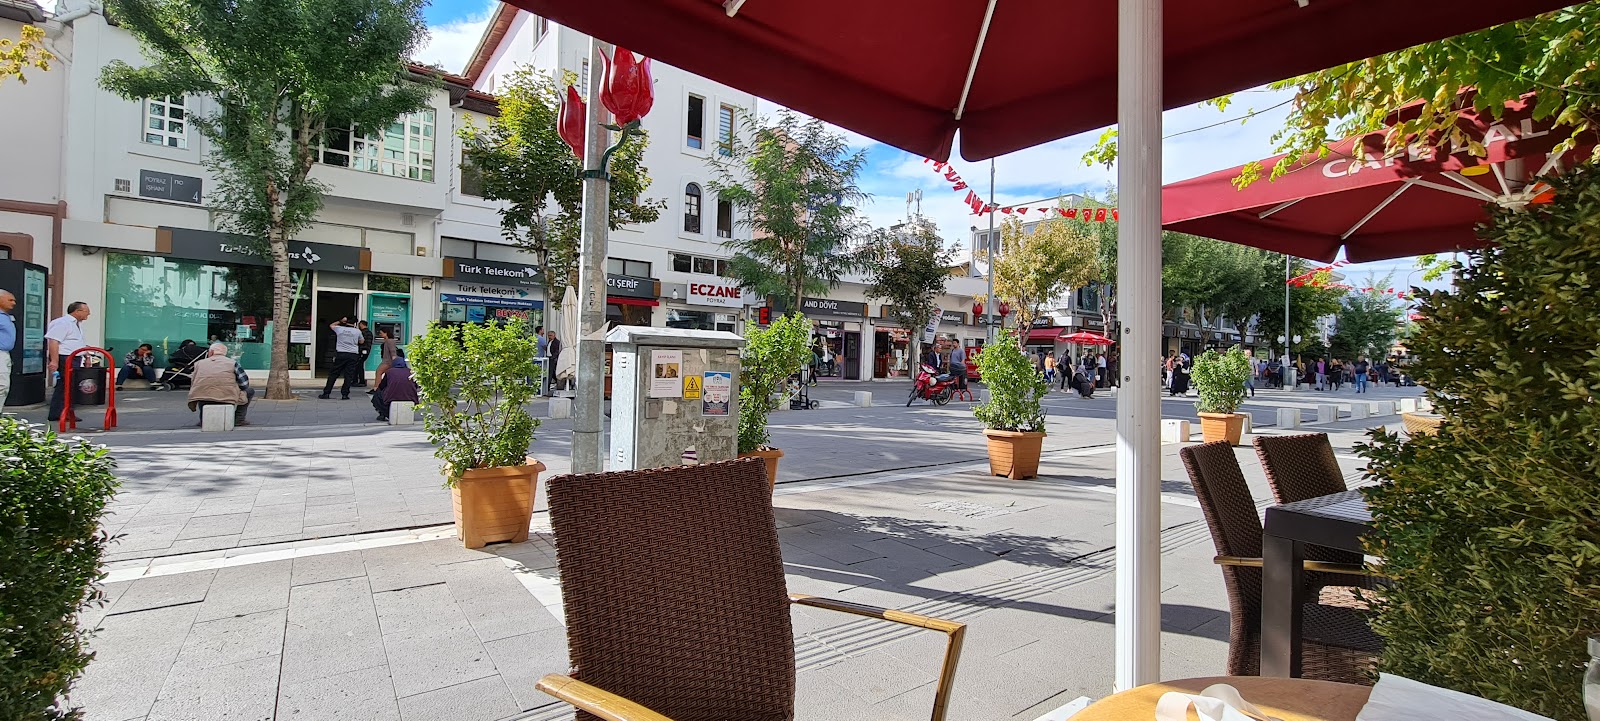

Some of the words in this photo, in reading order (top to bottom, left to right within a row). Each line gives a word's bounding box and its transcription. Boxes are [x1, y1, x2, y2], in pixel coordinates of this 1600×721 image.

[145, 176, 167, 185] POYRAZ
[192, 190, 199, 202] 4
[459, 263, 481, 274] Türk
[484, 266, 524, 278] Telekom
[457, 284, 477, 293] Türk
[480, 286, 515, 296] Telekom
[616, 279, 639, 289] ŞERİF
[690, 283, 741, 299] ECZANE
[804, 300, 817, 308] AND
[819, 300, 838, 310] DÖVİZ
[496, 309, 529, 320] BEYZA
[760, 308, 768, 324] E
